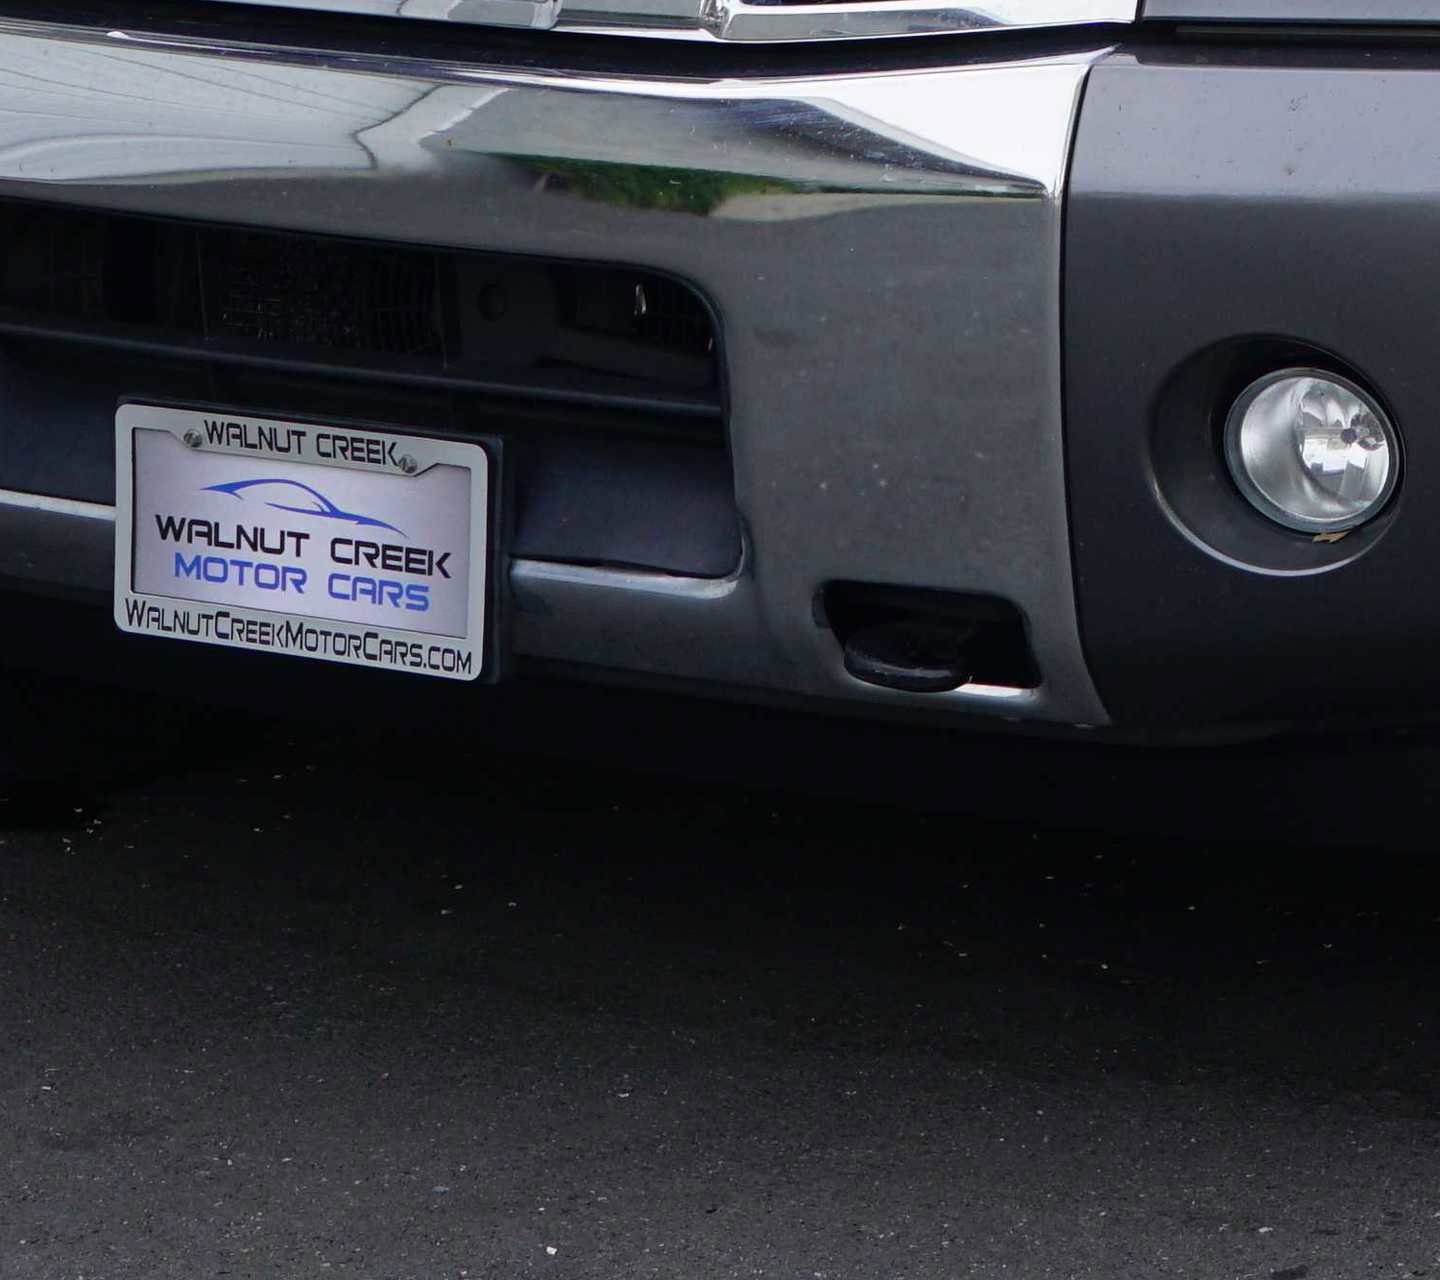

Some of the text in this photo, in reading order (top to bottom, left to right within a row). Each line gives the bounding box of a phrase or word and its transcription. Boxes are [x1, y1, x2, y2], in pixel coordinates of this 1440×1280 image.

[204, 419, 401, 467] WALNUT CREEK
[155, 513, 452, 579] WALNUT CREEK
[174, 552, 431, 612] MOTOR CARS
